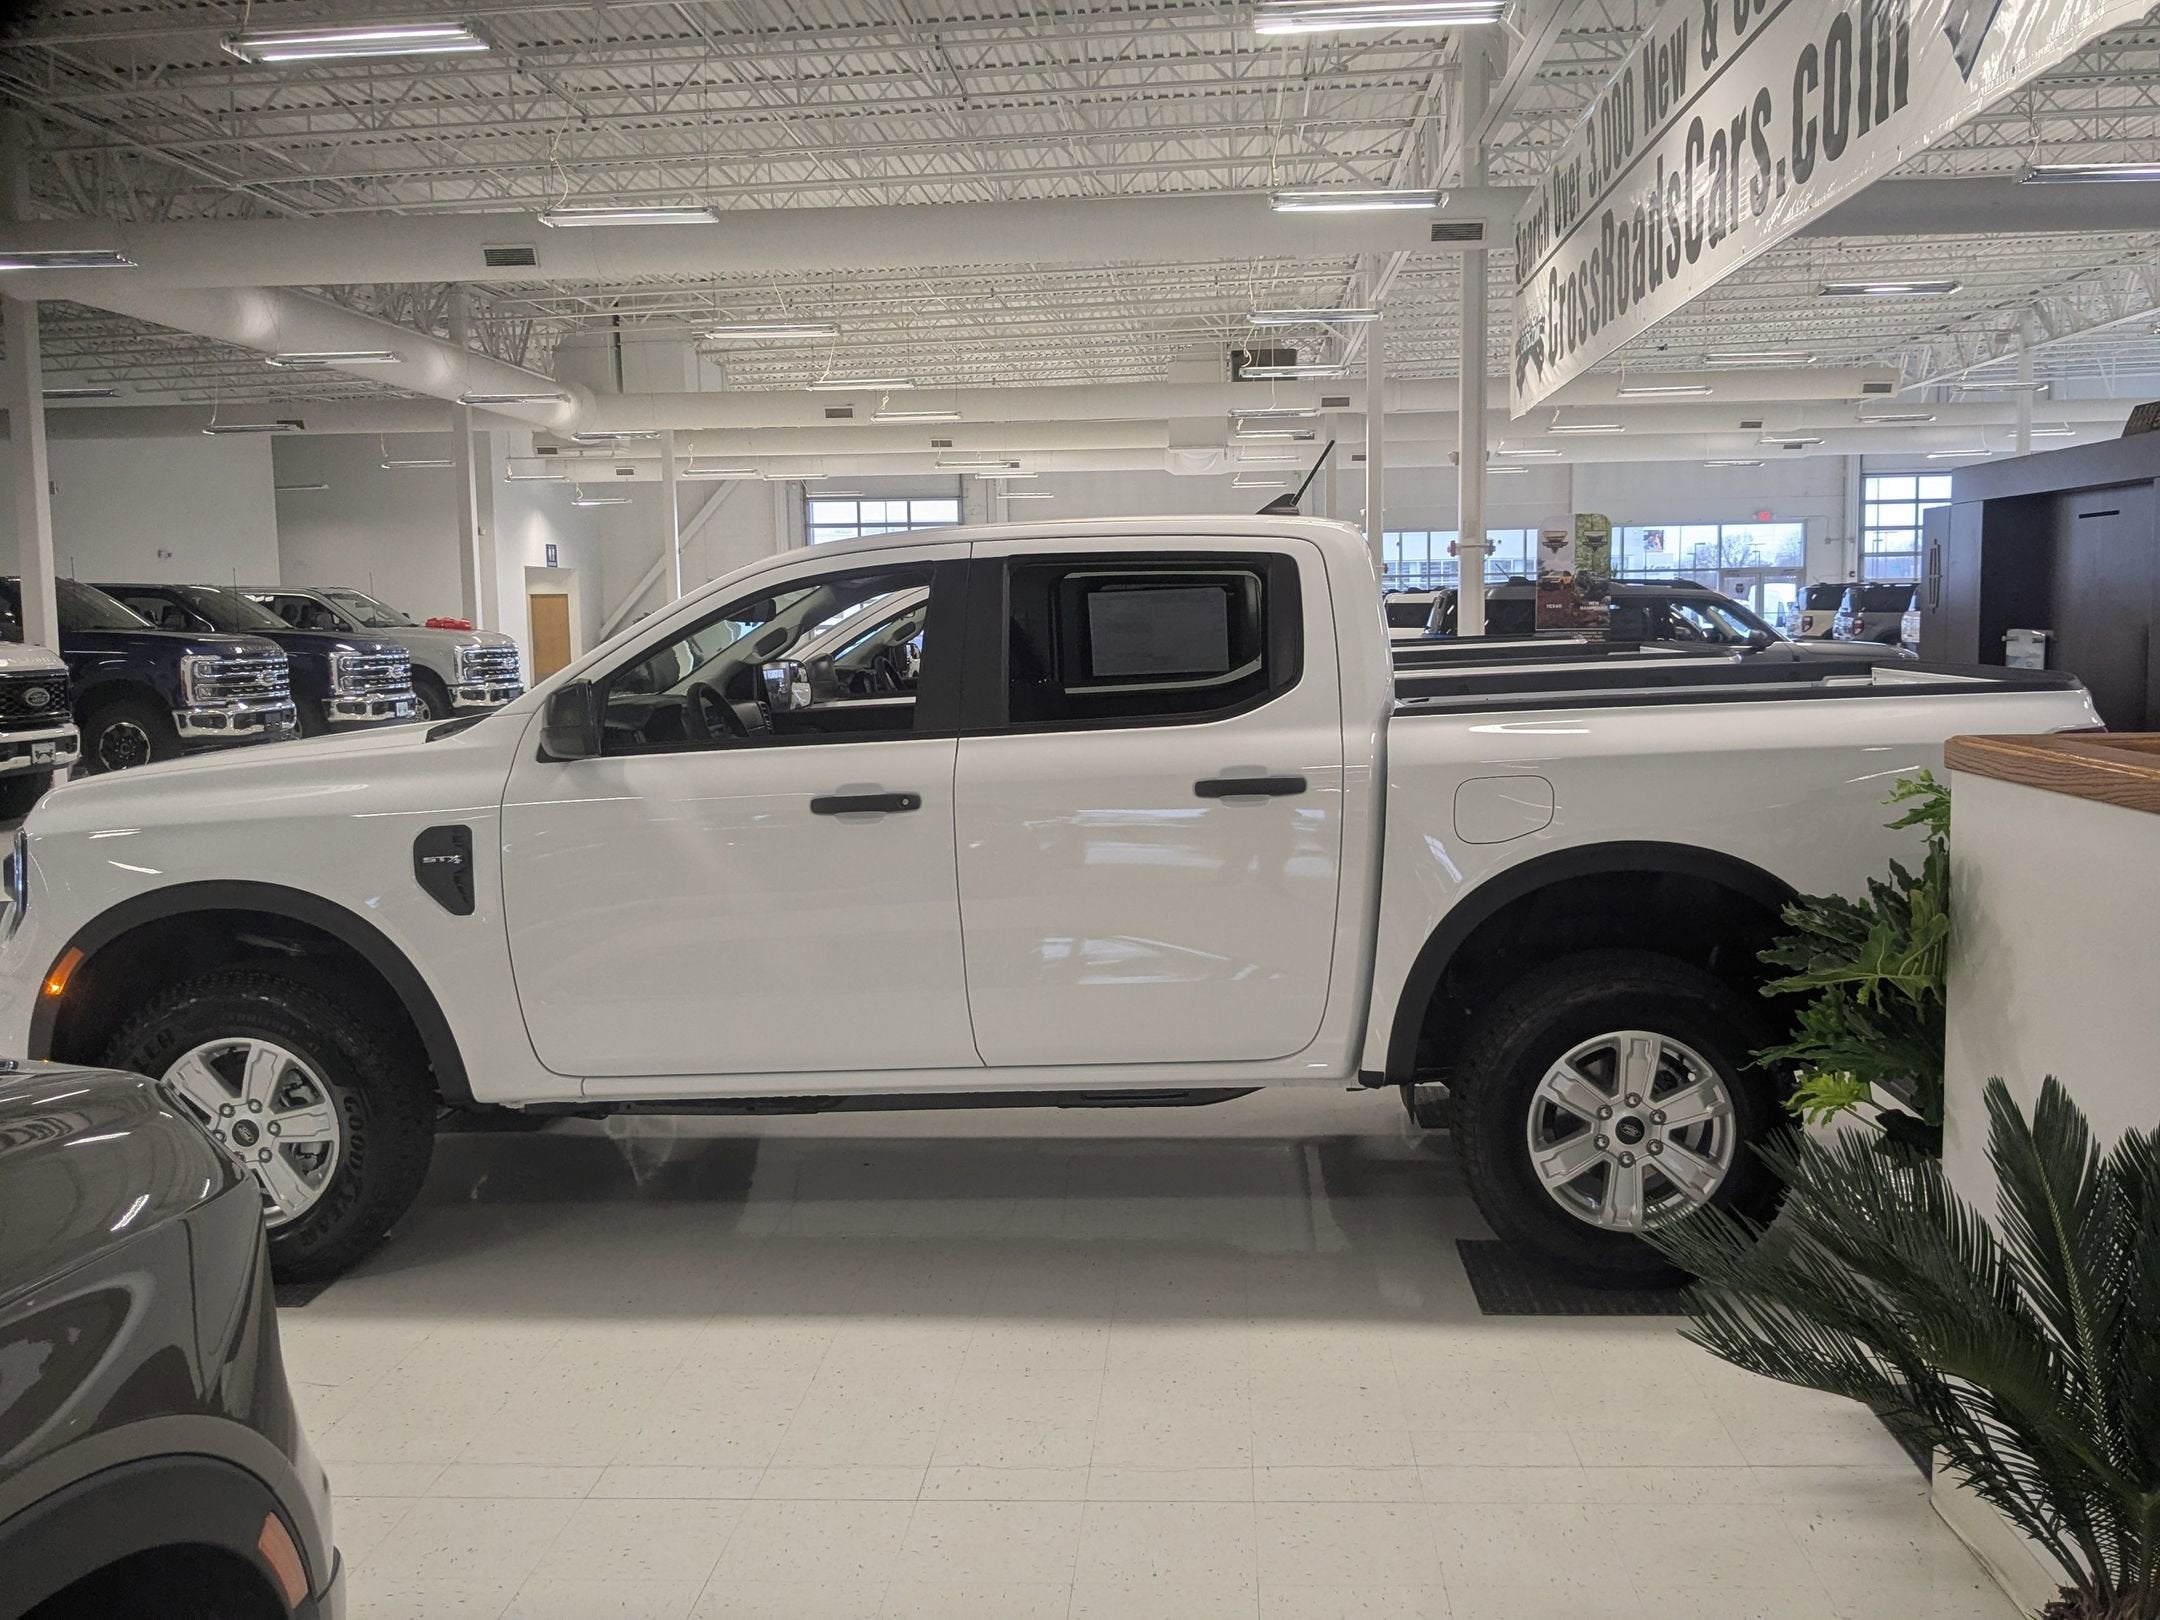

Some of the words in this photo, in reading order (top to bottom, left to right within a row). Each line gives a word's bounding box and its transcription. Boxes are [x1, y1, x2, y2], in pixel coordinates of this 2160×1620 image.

[1515, 181, 1550, 286] Search
[1553, 152, 1581, 239] Over
[1587, 66, 1634, 200] 3,000
[1643, 17, 1688, 137] New
[1549, 0, 1910, 367] CrossRoadsCars.com
